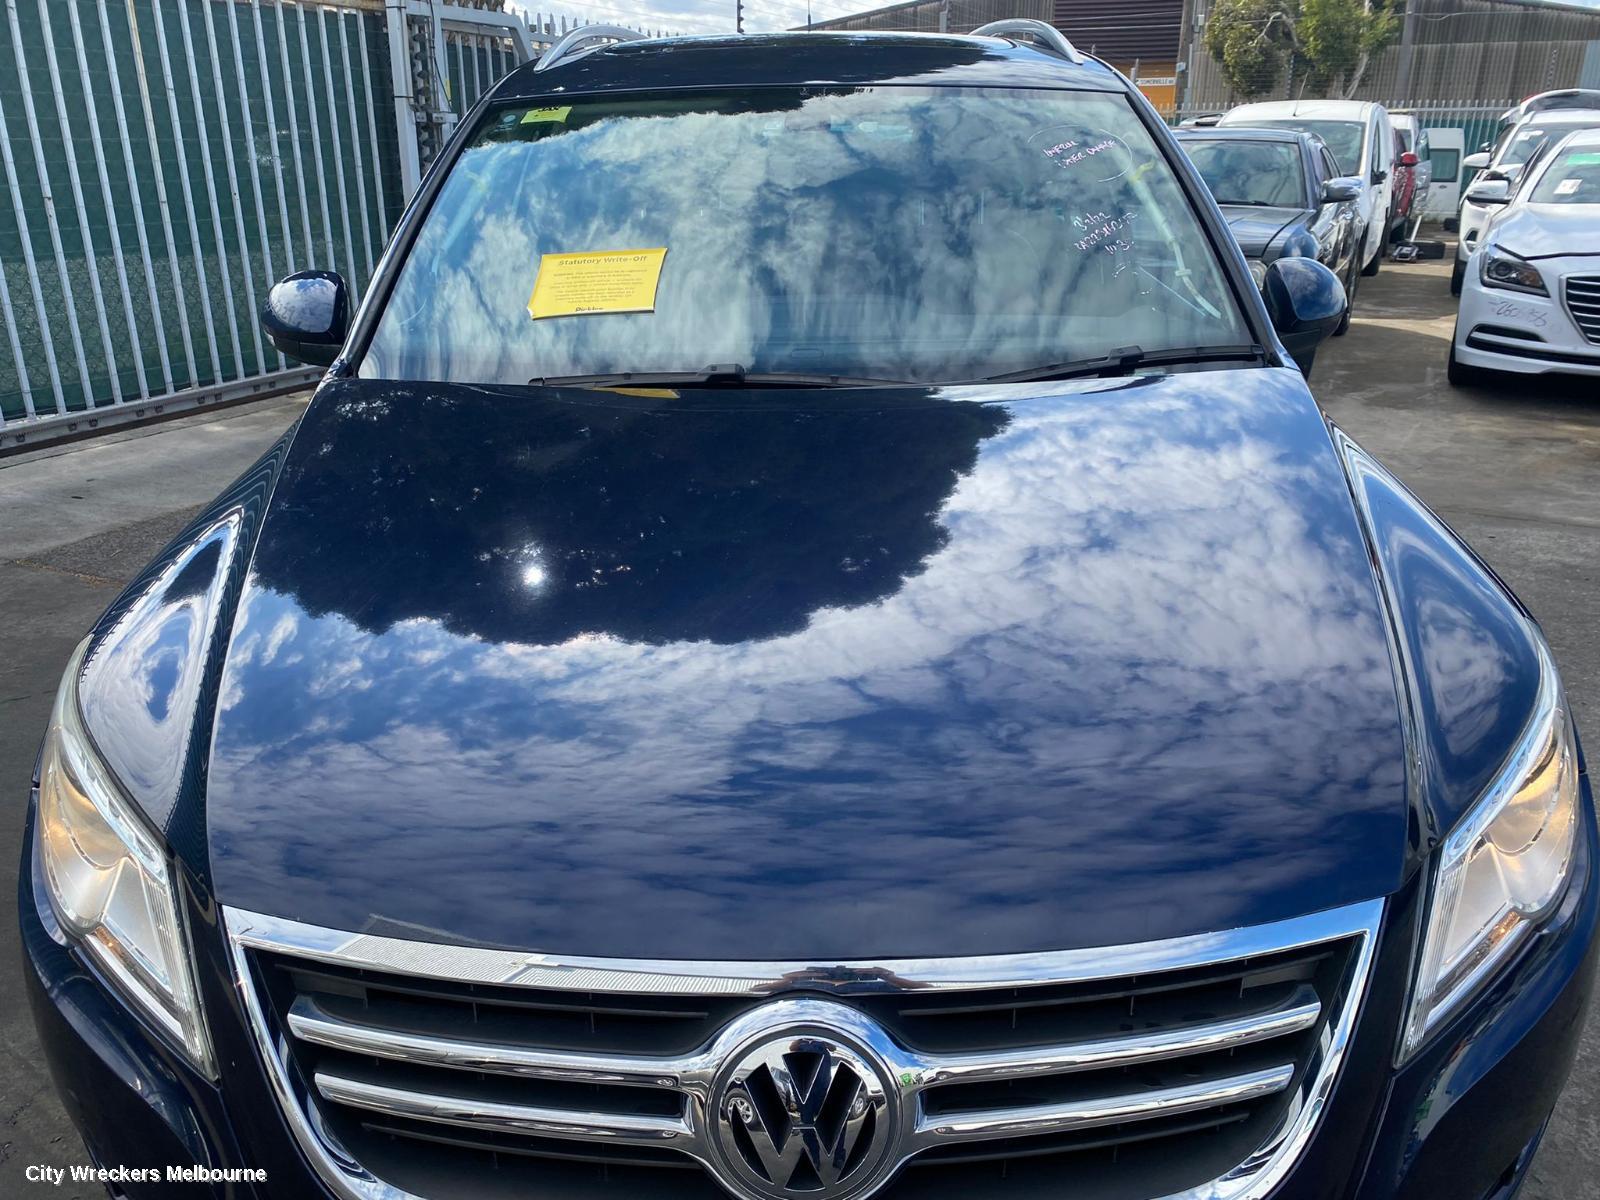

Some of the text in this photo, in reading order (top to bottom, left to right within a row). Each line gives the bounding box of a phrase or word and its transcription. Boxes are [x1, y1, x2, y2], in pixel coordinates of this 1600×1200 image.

[559, 256, 648, 266] Statutory Write-Off
[719, 1035, 888, 1198] VW
